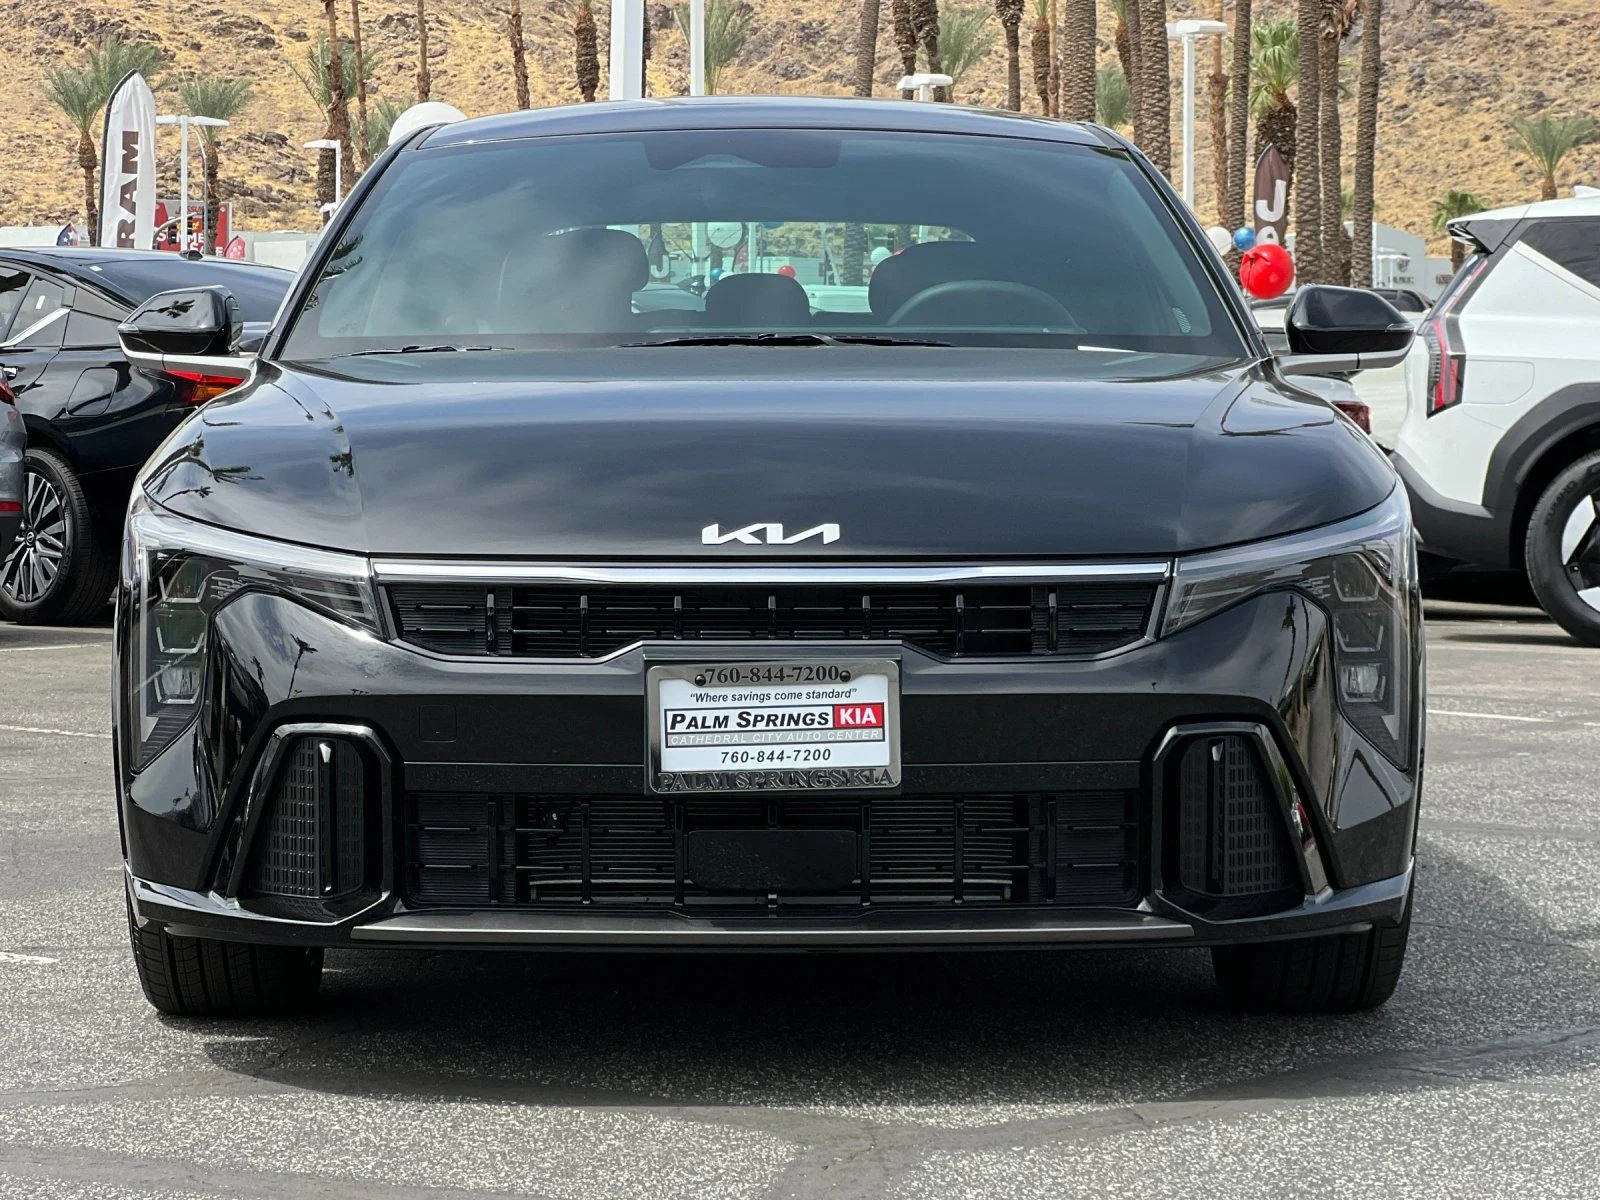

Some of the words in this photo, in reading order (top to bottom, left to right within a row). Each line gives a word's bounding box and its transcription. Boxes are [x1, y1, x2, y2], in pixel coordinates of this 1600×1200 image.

[116, 130, 139, 248] RAM
[704, 665, 839, 684] 760-844-7200
[731, 691, 771, 703] savings
[774, 692, 803, 700] come
[839, 707, 877, 725] KIA
[671, 734, 747, 745] CATHEDRAL
[752, 733, 784, 743] CITY
[787, 732, 822, 742] AUTO
[827, 730, 879, 741] CENTER
[721, 748, 831, 763] 760-844-7200
[658, 772, 730, 792] PALM
[847, 768, 896, 787] KIA
